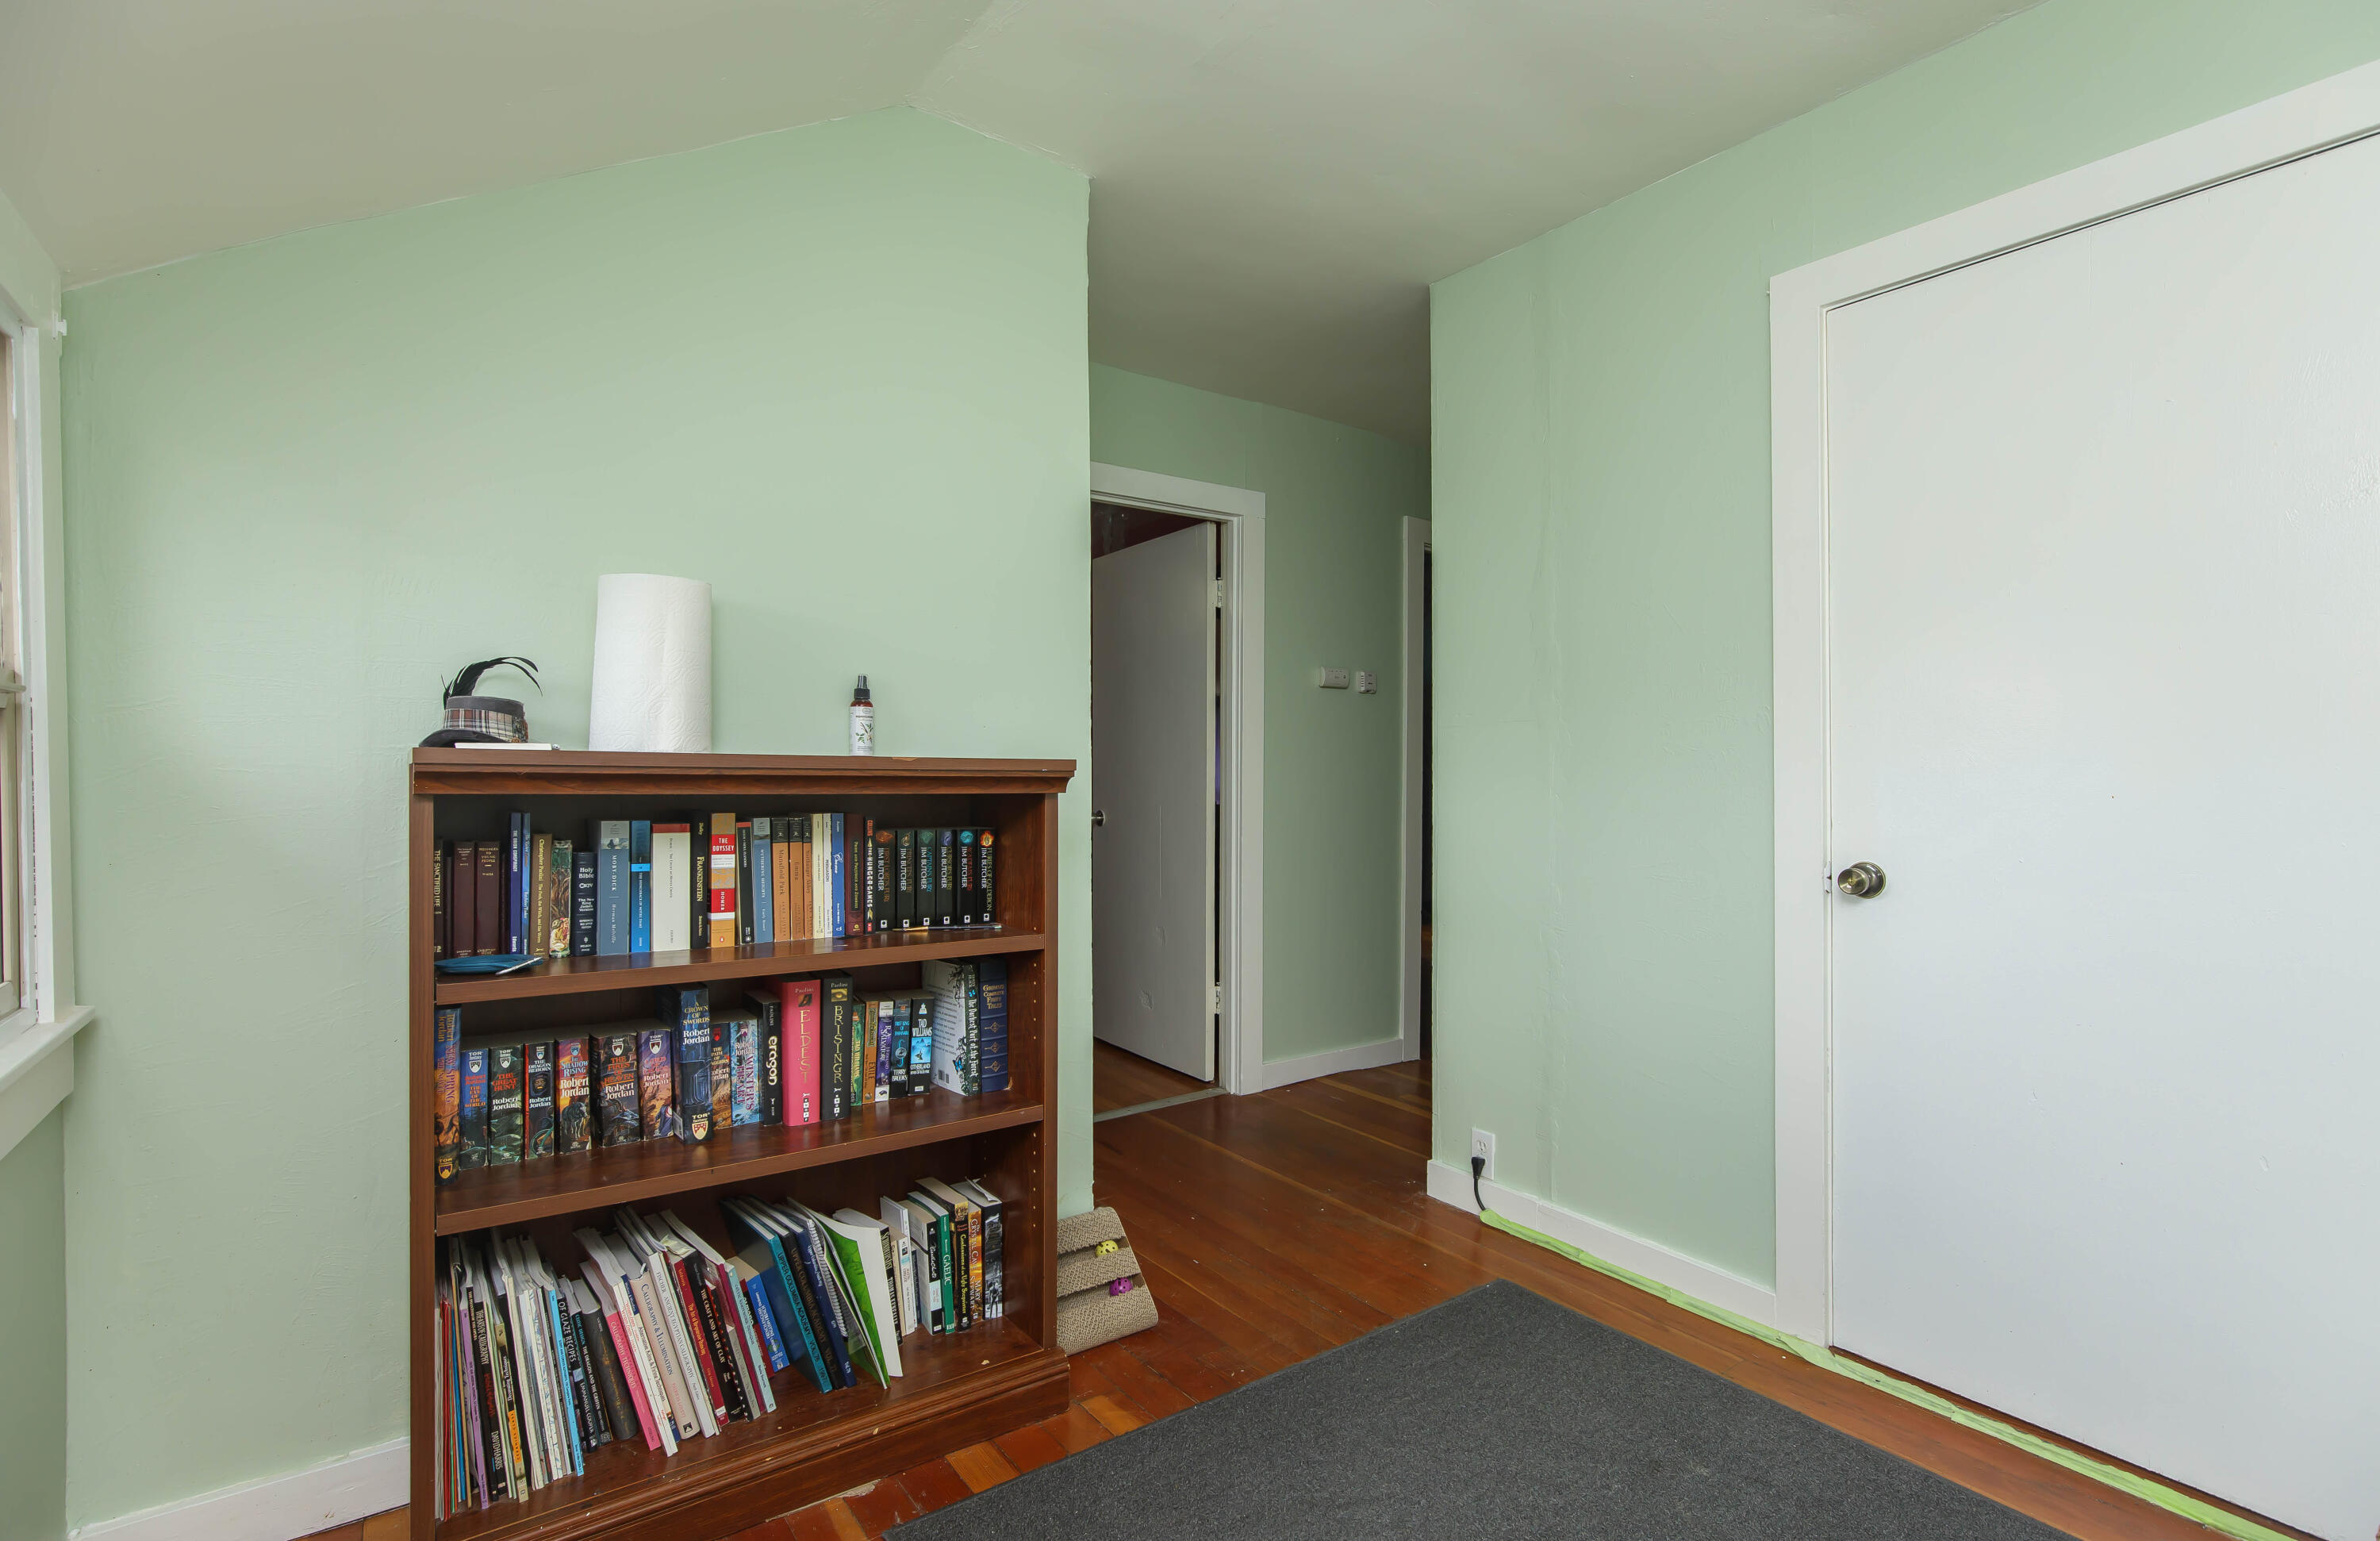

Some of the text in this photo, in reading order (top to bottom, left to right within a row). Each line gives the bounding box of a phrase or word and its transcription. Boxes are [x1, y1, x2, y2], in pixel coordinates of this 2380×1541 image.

[968, 998, 977, 1008] The
[918, 1018, 927, 1027] TAD
[968, 1008, 977, 1029] Darkest
[683, 1028, 710, 1038] Robert
[912, 1027, 932, 1037] WILLIAMS
[969, 1029, 978, 1041] Part
[682, 1036, 710, 1045] Jordan
[735, 1040, 755, 1049] Robert
[799, 1009, 812, 1084] ELDEST
[833, 1005, 843, 1083] BRISINGR
[880, 1029, 889, 1063] SALVATORE
[735, 1047, 756, 1056] Jordan
[969, 1050, 978, 1059] the
[560, 1060, 589, 1070] SHADOW
[608, 1063, 631, 1071] FIRES
[766, 1036, 778, 1086] eragon
[969, 1059, 979, 1077] Forest
[444, 1044, 456, 1103] NEW SPRING
[563, 1067, 586, 1078] RISING
[605, 1074, 635, 1084] HEAVEN
[643, 1073, 669, 1082] Robert
[492, 1078, 517, 1086] GREAT
[560, 1078, 589, 1089] Robert
[605, 1082, 634, 1093] Robert
[643, 1079, 669, 1088] Jordan
[736, 1064, 746, 1105] HEART
[746, 1055, 754, 1111] WINTER'S
[560, 1086, 589, 1099] Jordan
[605, 1089, 635, 1101] Jordan
[703, 1300, 712, 1318] CRAFT
[887, 1278, 899, 1324] THOMAS KENEALLY
[558, 1301, 576, 1362] OF GLAZE RECIPES
[641, 1283, 658, 1326] CALLIGRAPHY
[656, 1334, 674, 1376] ILLUMINATION
[656, 1271, 693, 1378] FISCHER ANCIENT EGYPTIAN CALLIGRAPHY
[693, 1322, 701, 1339] Responsive
[638, 1326, 650, 1349] Alternative
[478, 1332, 489, 1365] CALLIGRAPHY
[610, 1321, 624, 1355] CALLIGRAPHY
[620, 1356, 636, 1388] TECHNIQUES
[696, 1339, 705, 1355] Drawing
[645, 1350, 654, 1361] Kilns
[584, 1355, 593, 1374] DRAGON
[650, 1366, 658, 1378] Firing
[653, 1378, 666, 1401] Techniques
[579, 1382, 594, 1433] EMMANUEL COOPER
[491, 1430, 503, 1470] DAVID HARRIS
